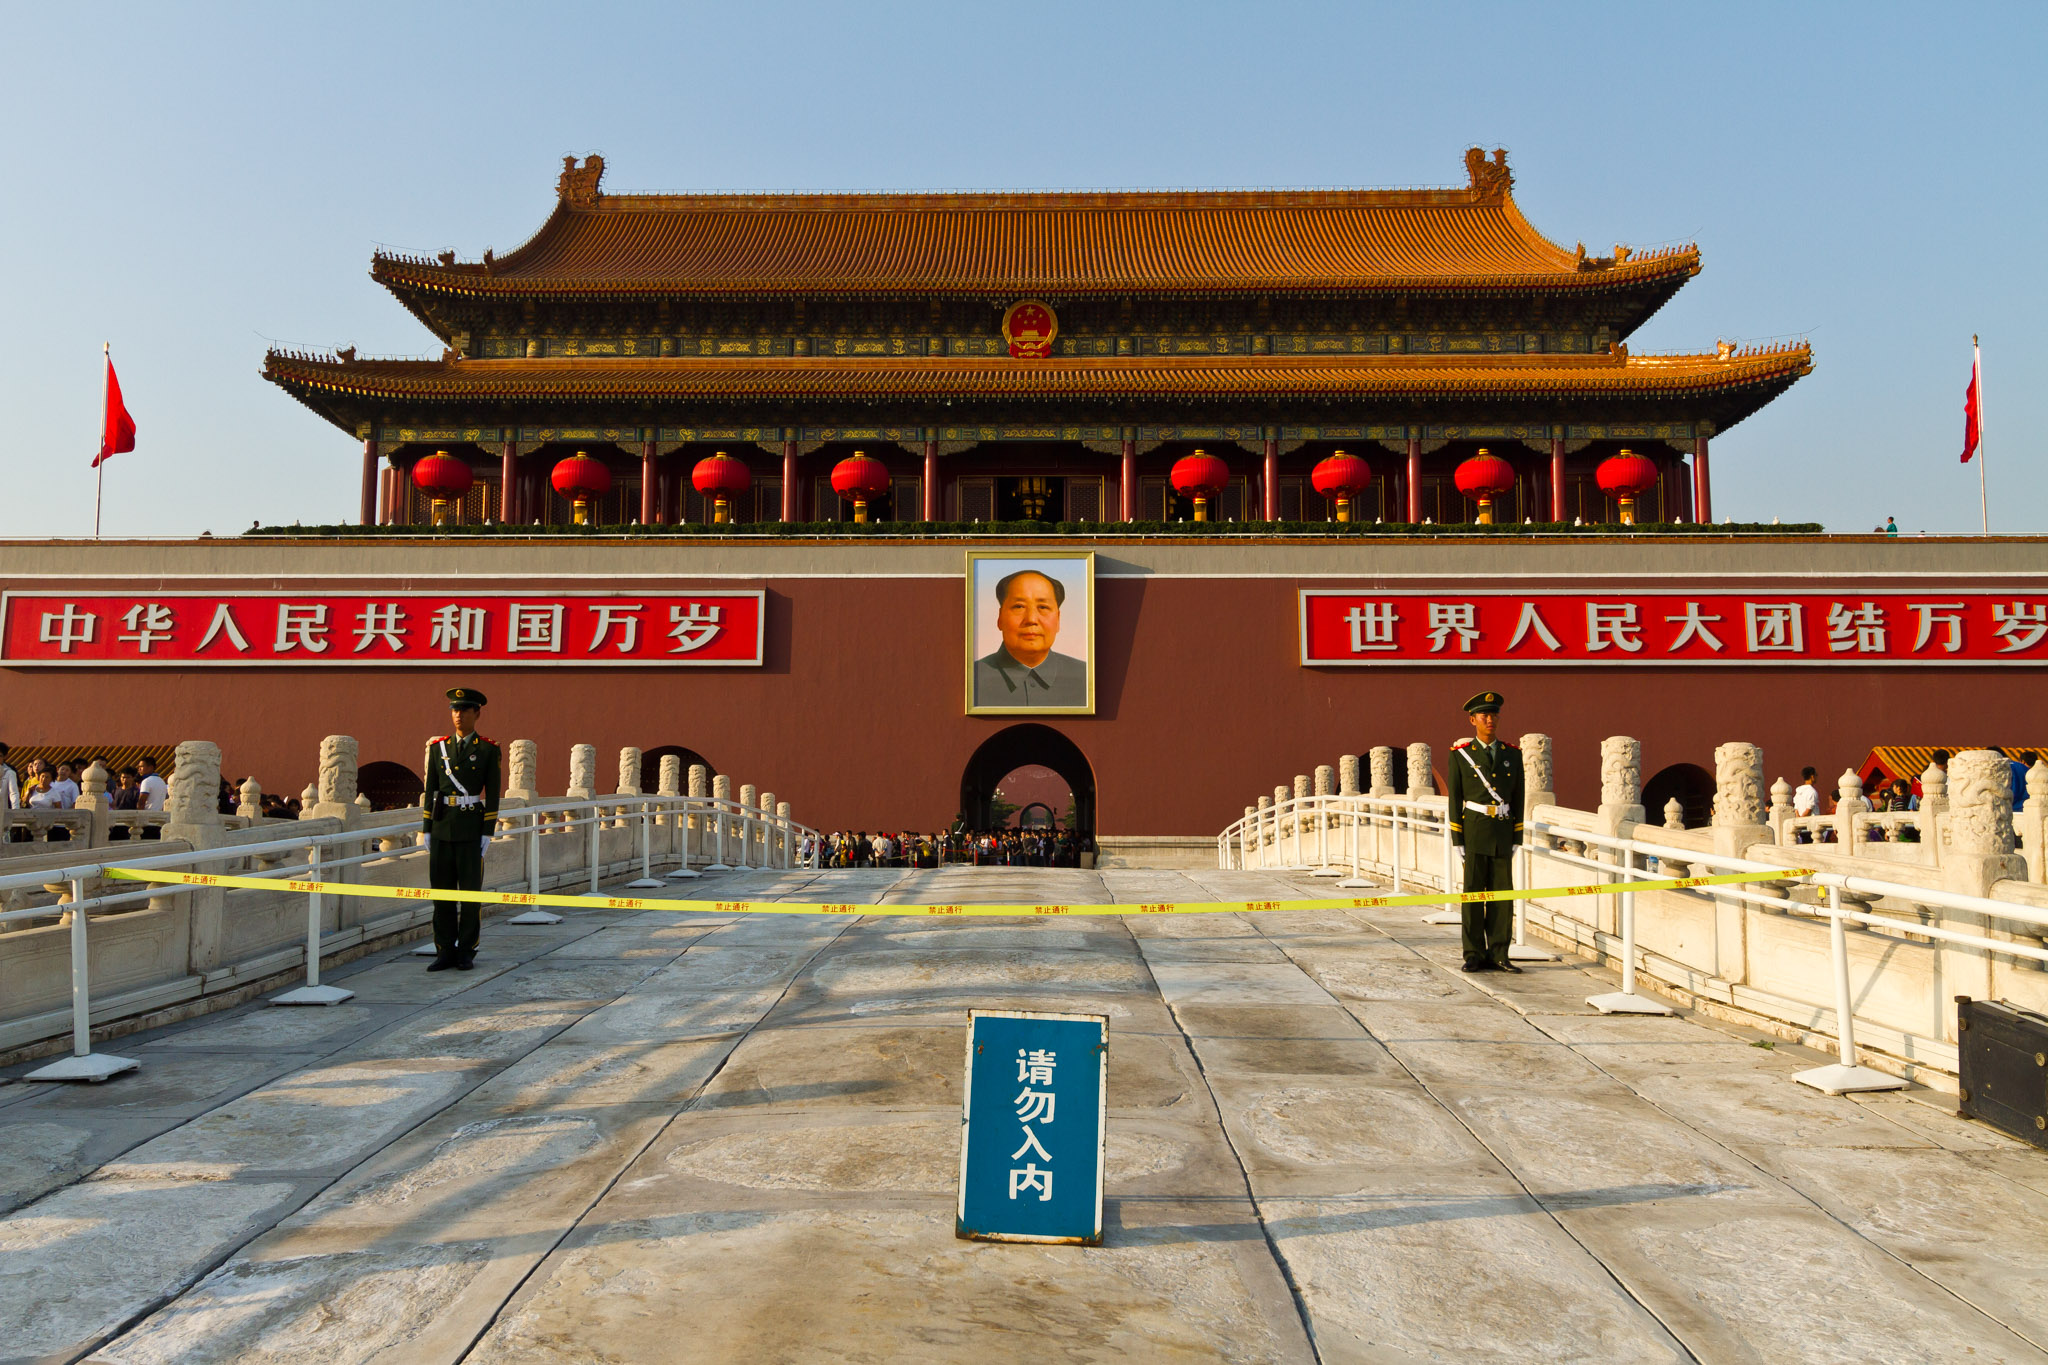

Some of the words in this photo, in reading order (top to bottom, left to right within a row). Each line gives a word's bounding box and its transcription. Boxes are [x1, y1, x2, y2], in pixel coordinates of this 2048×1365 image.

[39, 603, 721, 654] 中华人民共和国万岁
[1343, 602, 2048, 654] 世界人民大团结万岁
[183, 874, 217, 885] 禁止通行
[288, 881, 323, 892] 禁止通行
[395, 888, 430, 899] 禁止通行
[501, 893, 537, 904] 禁止通行
[607, 898, 643, 908] 禁止通行
[715, 902, 749, 912] 禁止通行
[821, 904, 856, 913] 禁止通行
[928, 905, 963, 915] 禁止通行
[1034, 905, 1069, 915] 禁止通行
[1139, 903, 1175, 913] 禁止通行
[1245, 901, 1281, 911] 禁止通行
[1353, 897, 1388, 907] 禁止通行
[1460, 892, 1495, 902] 禁止通行
[1567, 886, 1603, 895] 禁止通行
[1674, 877, 1710, 887] 禁止通行
[1008, 1048, 1057, 1202] 请勿入内
